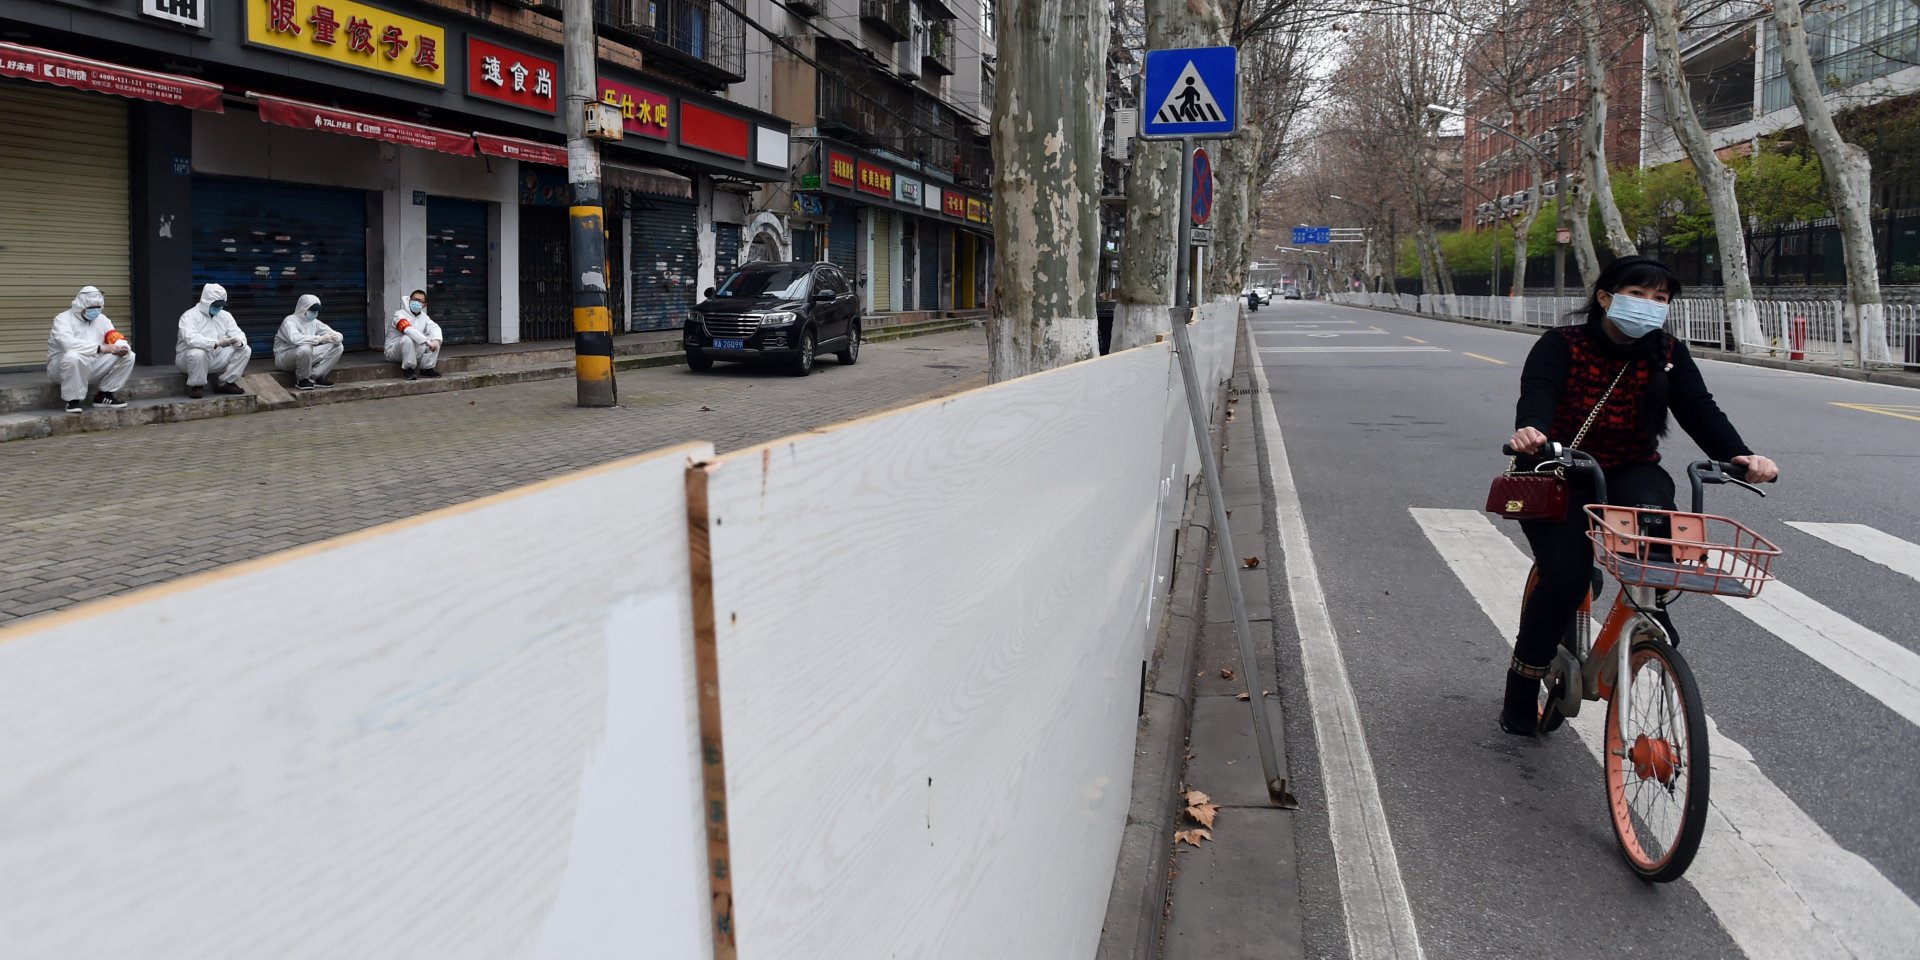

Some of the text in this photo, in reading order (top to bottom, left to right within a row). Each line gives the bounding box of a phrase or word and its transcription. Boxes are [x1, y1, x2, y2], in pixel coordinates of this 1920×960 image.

[267, 0, 440, 72] 限量饺子屋
[7, 60, 35, 73] 好未来
[482, 56, 552, 99] 速食尚
